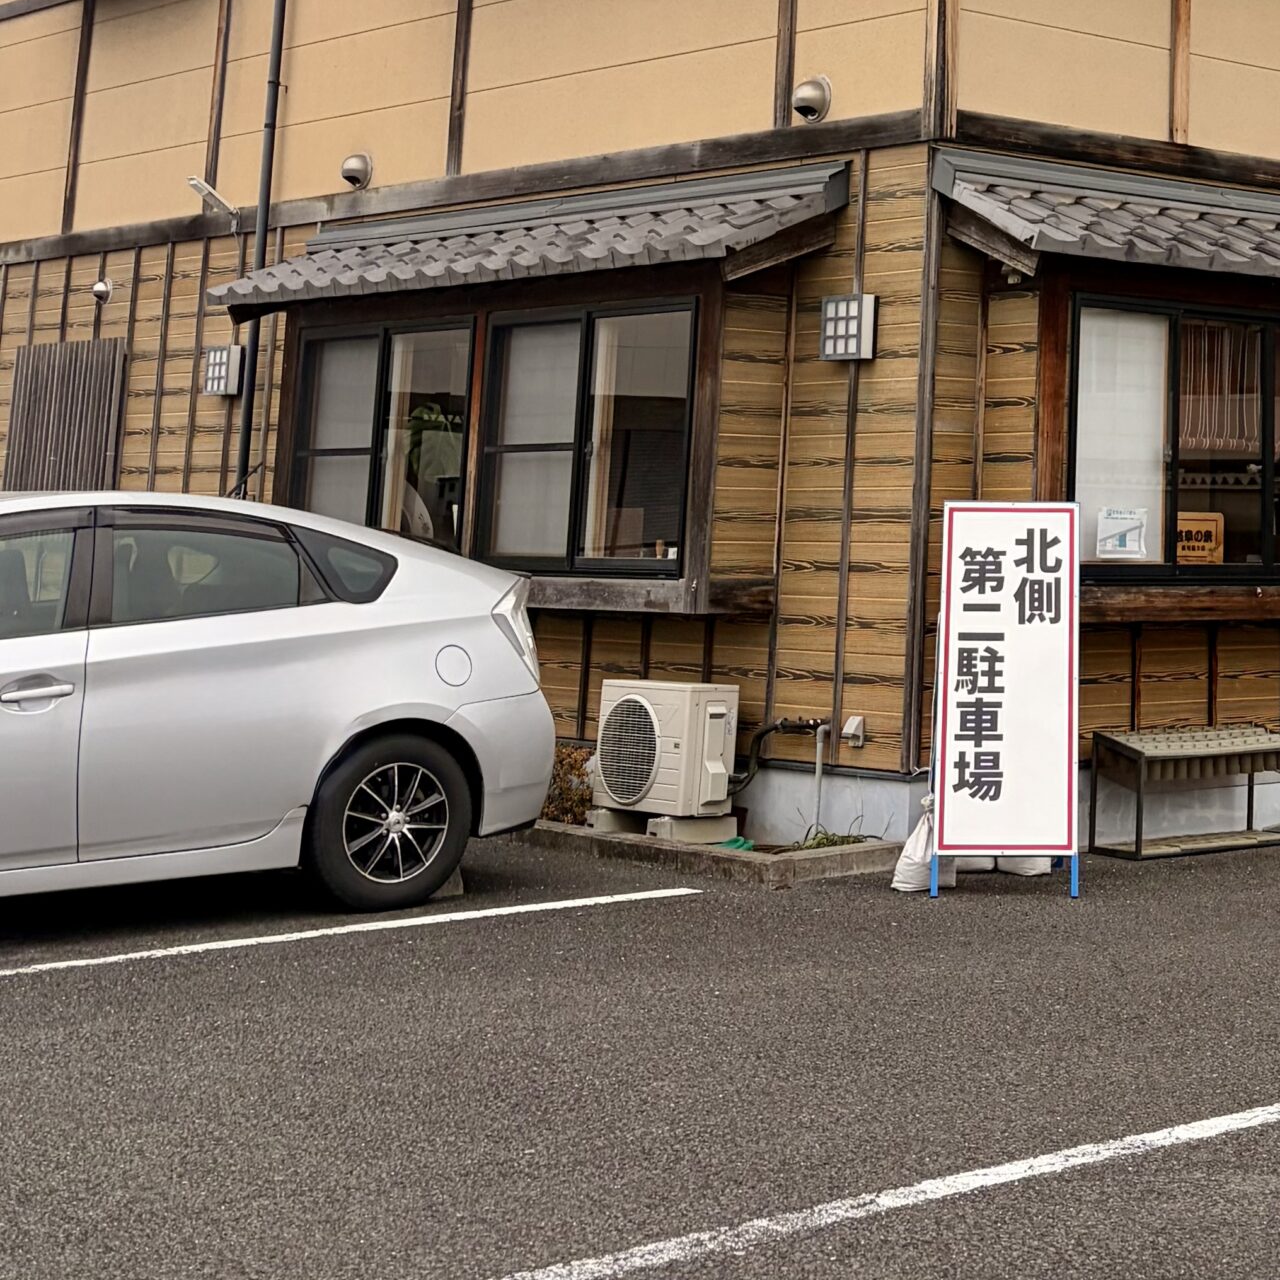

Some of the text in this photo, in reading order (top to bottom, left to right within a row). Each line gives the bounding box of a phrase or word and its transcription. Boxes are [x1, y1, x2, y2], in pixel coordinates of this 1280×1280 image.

[1014, 528, 1063, 625] 北側
[952, 547, 1007, 802] 第二駐車場
